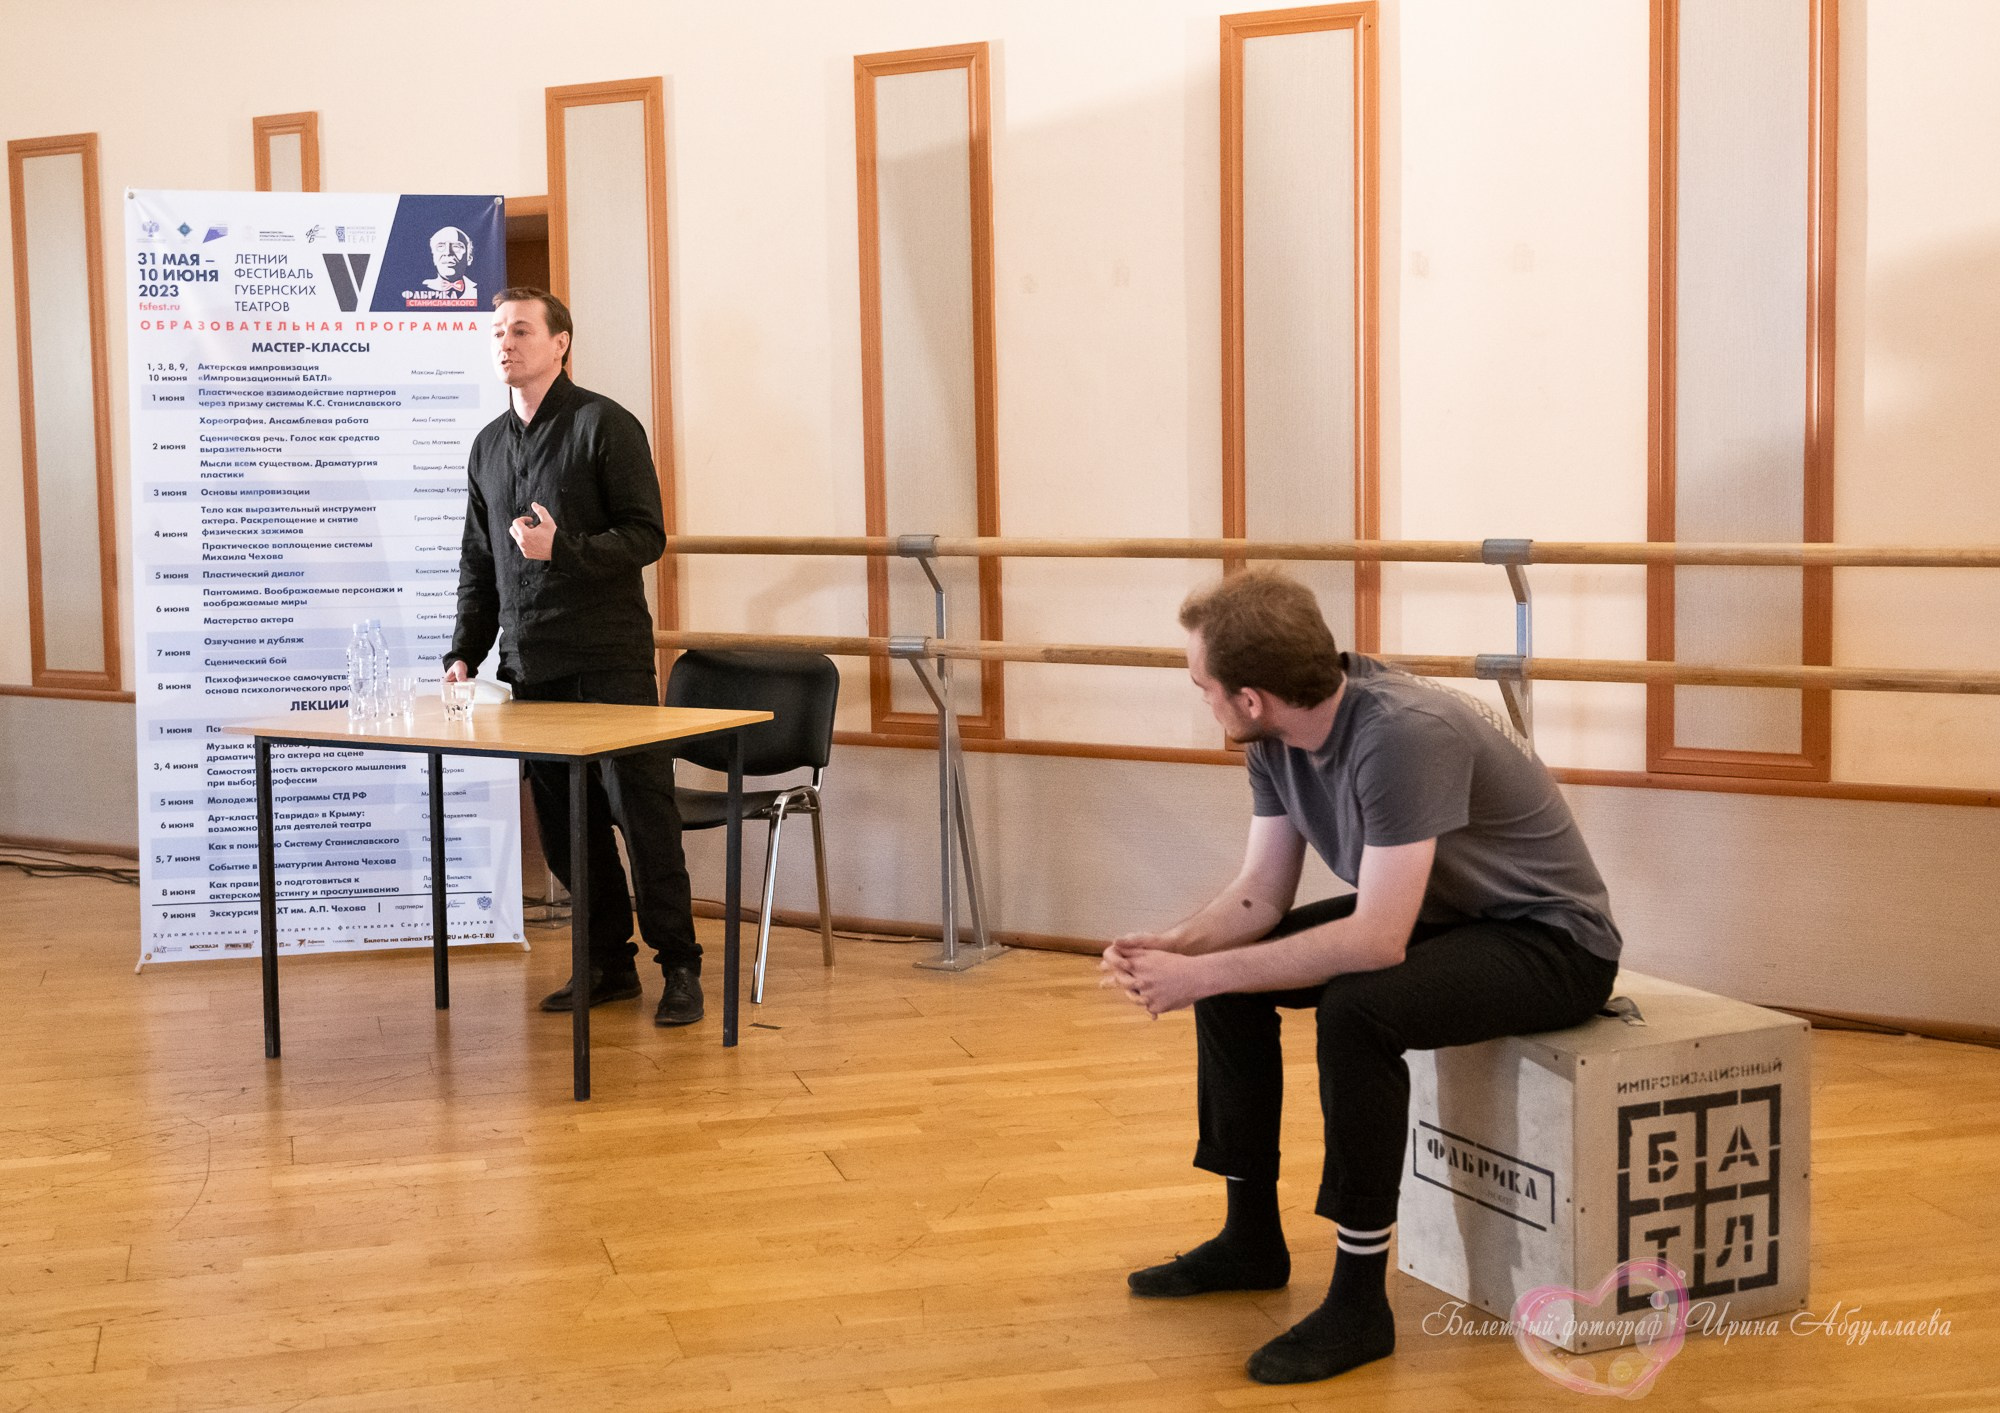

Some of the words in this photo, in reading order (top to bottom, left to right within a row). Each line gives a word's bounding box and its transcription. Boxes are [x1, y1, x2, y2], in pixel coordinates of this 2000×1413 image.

[138, 253, 158, 265] 31
[162, 254, 200, 266] МАЯ
[235, 252, 288, 264] ЛЕТНИЙ
[139, 269, 158, 281] 10
[163, 269, 218, 282] ИЮНЯ
[234, 268, 314, 279] ФЕСТИВАЛЬ
[139, 285, 179, 297] 2023
[235, 285, 316, 296] ГУБЕРНСКИХ
[402, 290, 458, 300] ФАБРИКА
[139, 303, 180, 311] fsfest.ru
[235, 302, 290, 312] ТЕАТРОВ
[141, 321, 343, 331] ОБРАЗОВАТЕЛЬНАЯ
[356, 322, 478, 331] ПРОГРАММА
[252, 342, 369, 352] МАСТЕР-КЛАССЫ
[198, 363, 247, 372] Актерская
[198, 373, 300, 383] «Импровизационный
[267, 389, 344, 397] взаимодействие
[200, 417, 266, 426] Хореография.
[335, 417, 368, 425] работа
[315, 460, 377, 468] Драматургия
[246, 506, 320, 514] выразительный
[241, 517, 317, 525] Раскрепощение
[202, 529, 258, 537] физических
[202, 543, 269, 551] Практическое
[203, 570, 269, 578] Пластический
[265, 587, 339, 596] Воображаемые
[204, 599, 278, 608] воображаемые
[204, 638, 256, 646] Озвучание
[267, 636, 304, 645] дубляж
[205, 658, 266, 666] Сценический
[205, 676, 291, 684] Психофизическое
[290, 700, 348, 711] ЛЕКЦИИ
[207, 743, 244, 751] Музыка
[287, 751, 321, 759] актера
[275, 795, 330, 803] программы
[329, 810, 364, 819] Крыму:
[293, 822, 338, 831] деятелей
[284, 840, 323, 848] Систему
[325, 838, 399, 846] Станиславского
[209, 863, 250, 871] Событие
[285, 878, 351, 886] подготовиться
[320, 887, 399, 896] прослушиванию
[210, 910, 258, 918] Экскурсия
[1617, 1057, 1782, 1094] ИМПРОВИЗАЦИОННЫЙ
[1427, 1138, 1537, 1200] ФАБРИКА
